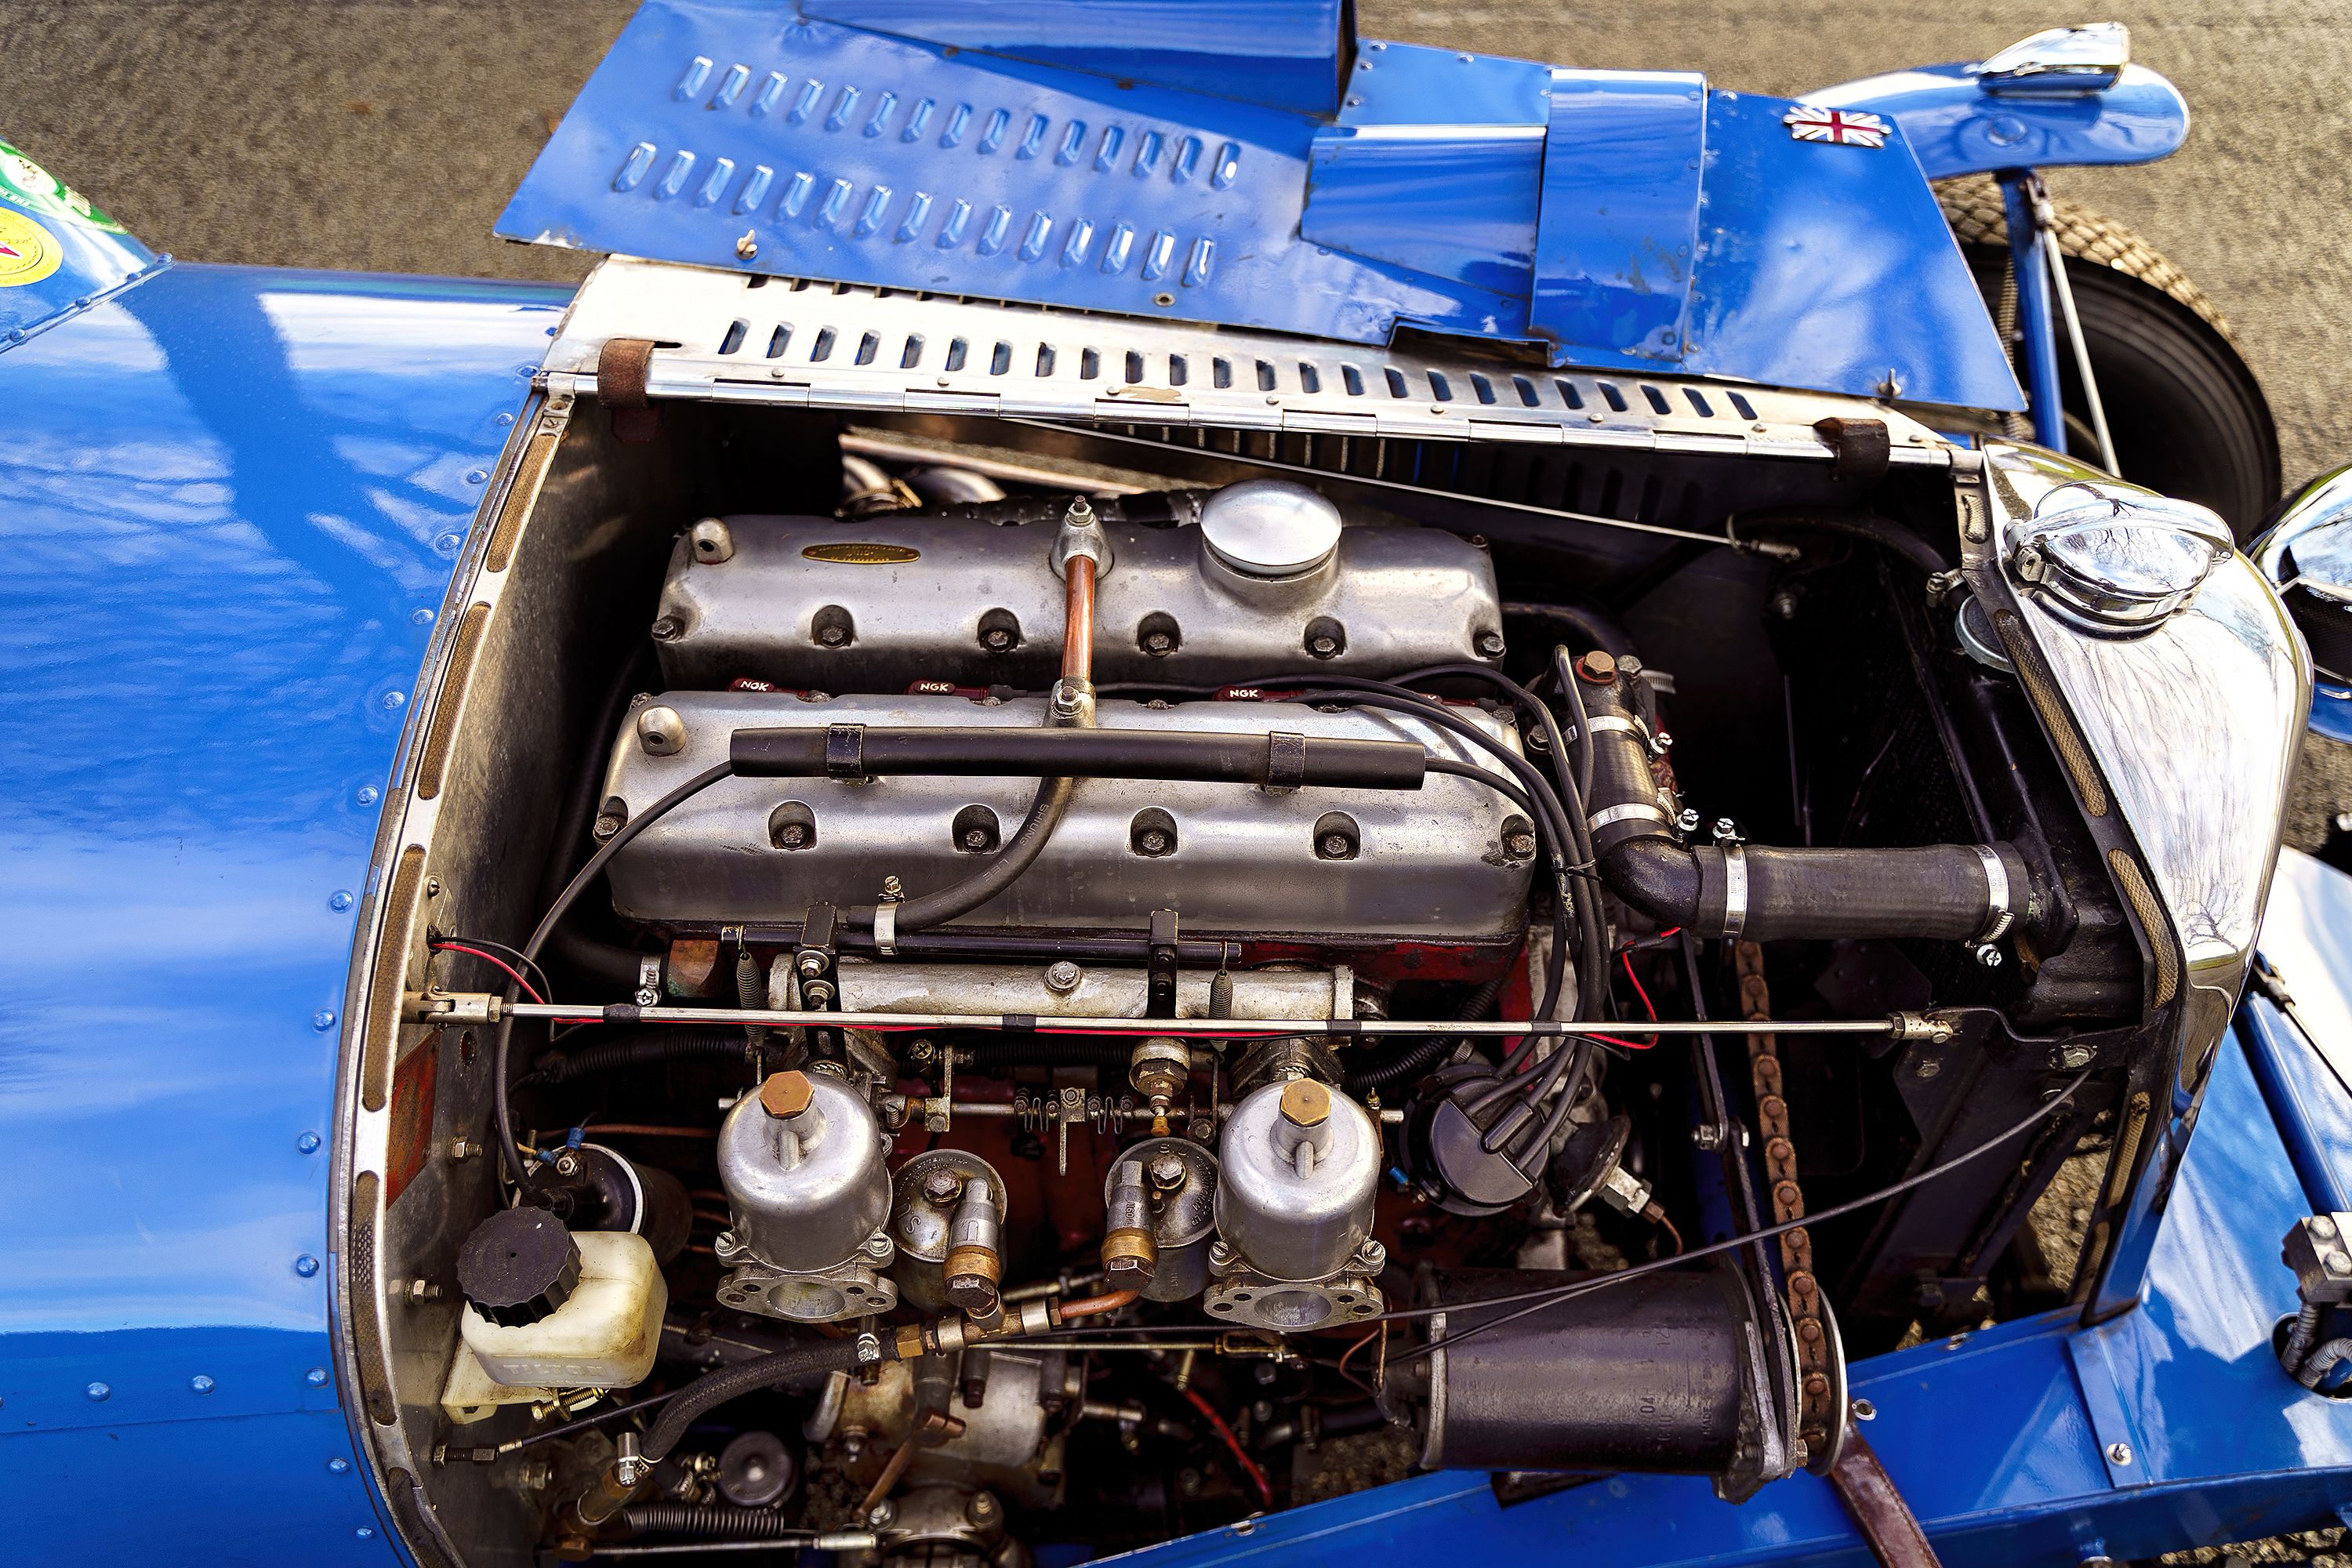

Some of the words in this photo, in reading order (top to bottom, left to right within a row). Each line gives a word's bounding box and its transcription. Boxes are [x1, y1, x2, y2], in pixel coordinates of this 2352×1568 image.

[920, 683, 949, 691] NGK
[1229, 689, 1258, 698] NGK
[1020, 803, 1050, 845] SHIUNG
[982, 858, 1009, 881] LEE
